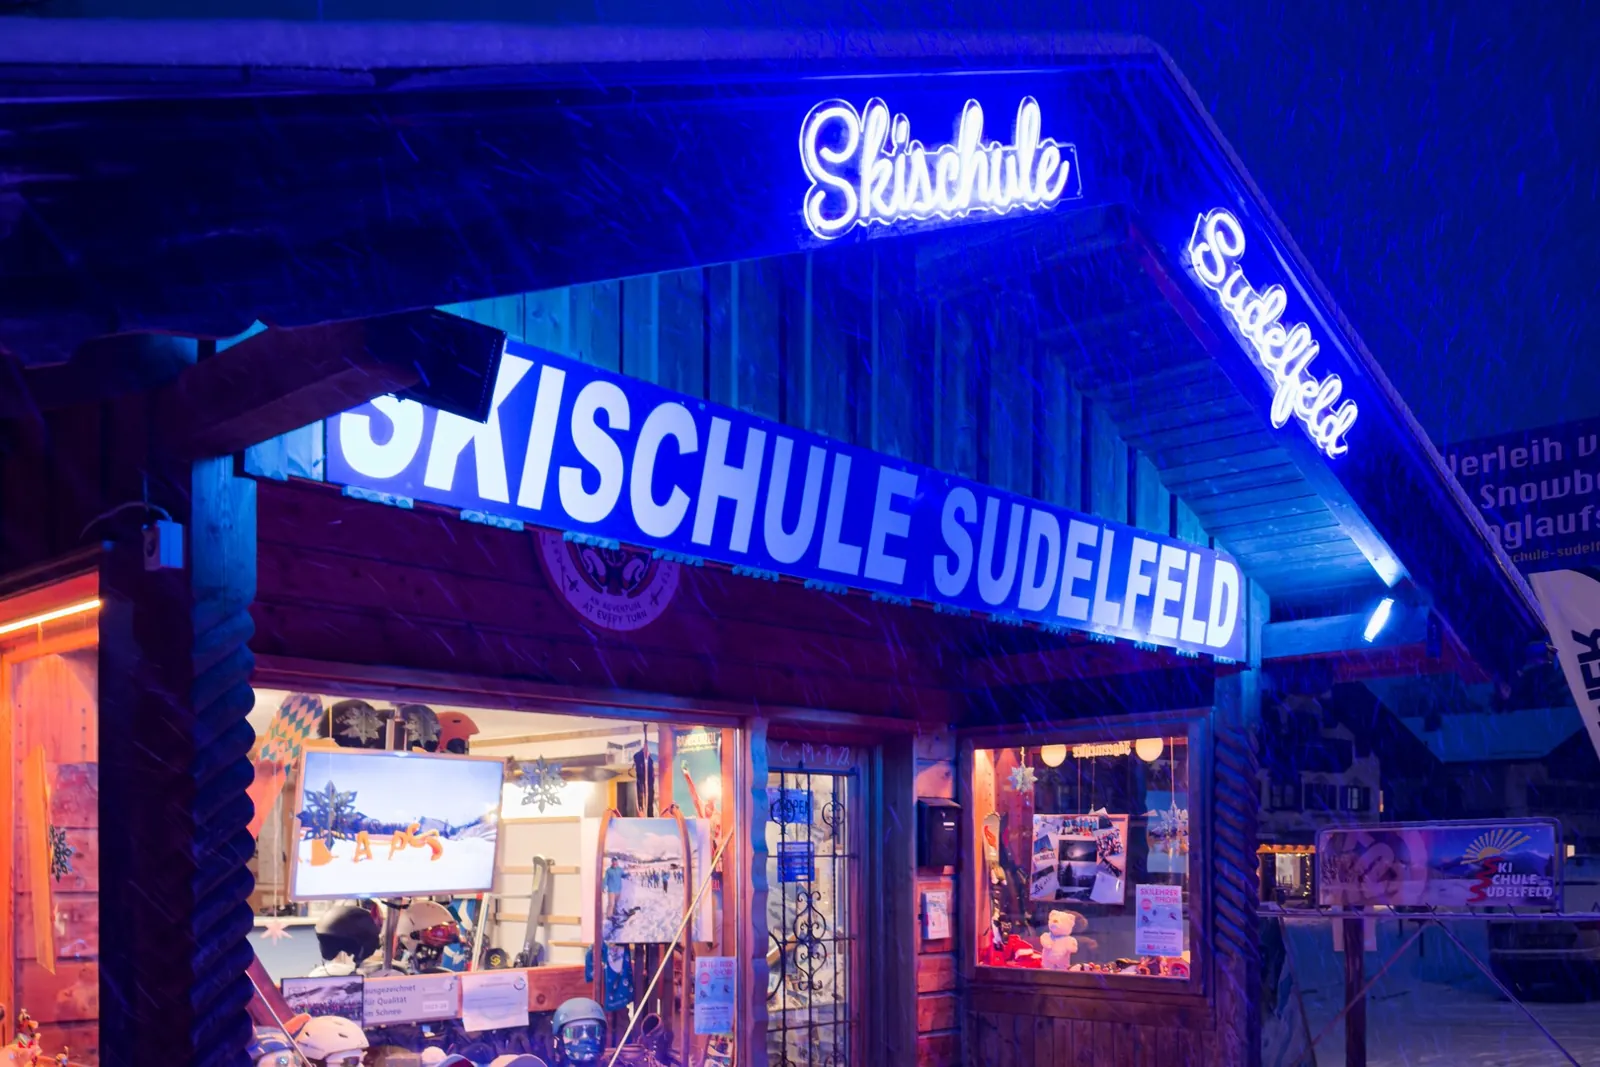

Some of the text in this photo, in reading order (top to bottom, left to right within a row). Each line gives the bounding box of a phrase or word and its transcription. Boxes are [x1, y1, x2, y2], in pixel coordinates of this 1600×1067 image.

[802, 100, 1071, 232] Skischule
[1193, 210, 1357, 456] Sudelfeld
[340, 354, 1240, 648] SKISCHULE SUDELFELD
[1480, 469, 1600, 509] Snowb
[626, 610, 648, 624] TURN
[364, 984, 416, 996] ausgezeichnet
[377, 996, 407, 1006] Qualität
[376, 1007, 402, 1017] Schnee
